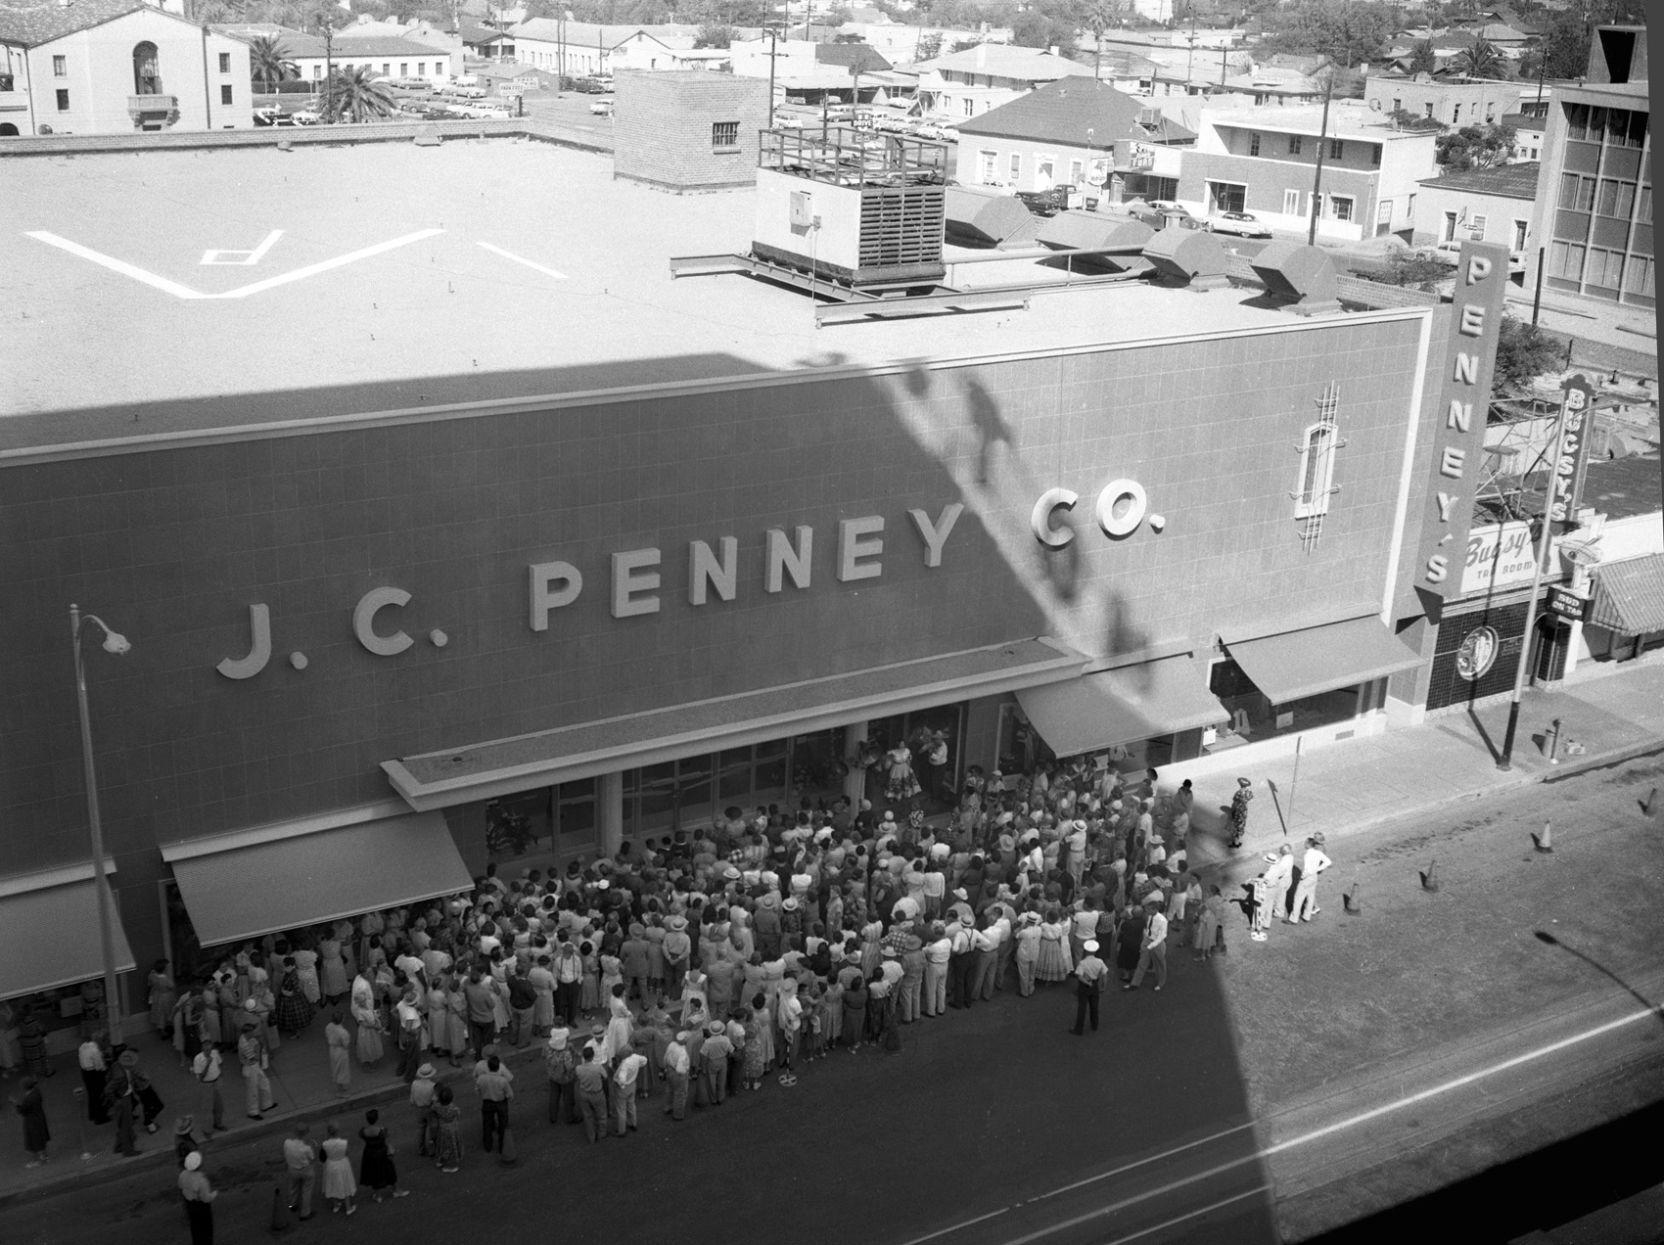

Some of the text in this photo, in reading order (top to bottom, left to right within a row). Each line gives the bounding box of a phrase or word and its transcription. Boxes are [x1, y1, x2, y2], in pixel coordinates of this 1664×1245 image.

[1426, 255, 1492, 582] PENNEY'S
[528, 503, 965, 632] PENNEY
[1030, 478, 1166, 550] CO.
